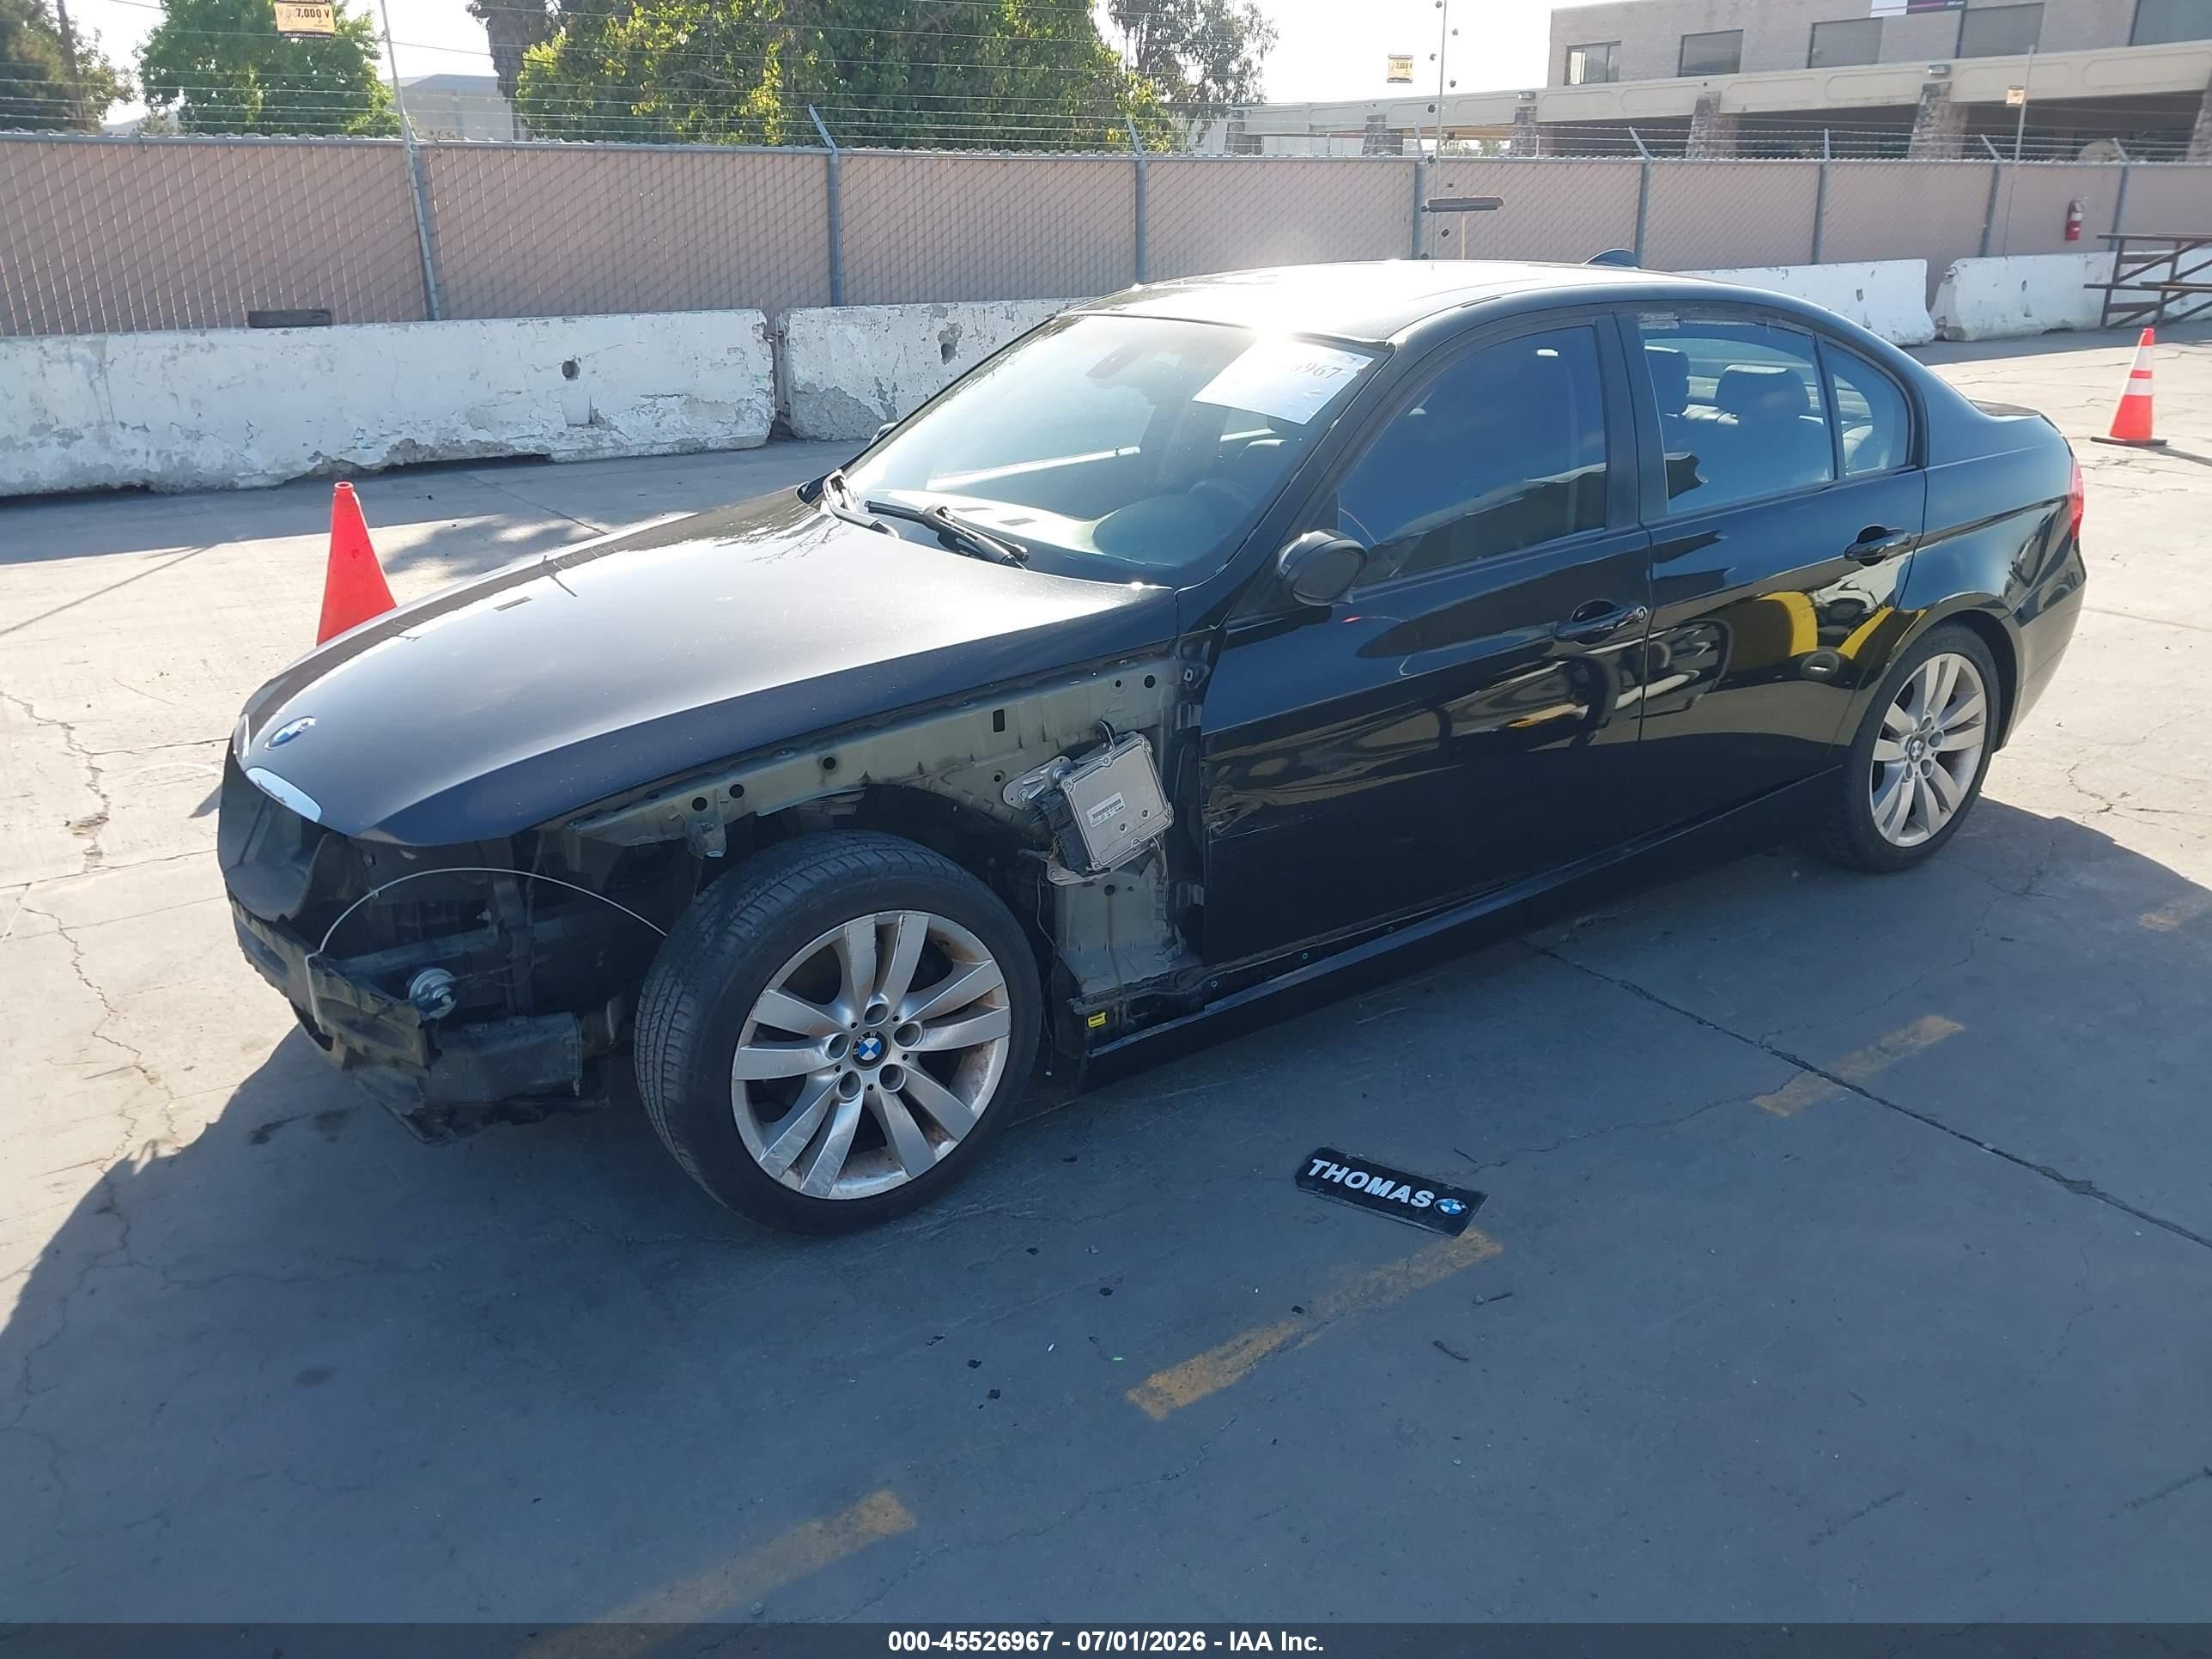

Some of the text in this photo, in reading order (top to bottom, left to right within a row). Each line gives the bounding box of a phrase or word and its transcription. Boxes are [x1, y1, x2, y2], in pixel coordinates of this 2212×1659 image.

[296, 8, 330, 18] 7,000 V
[852, 1030, 878, 1055] BMW
[1308, 1158, 1435, 1208] THOMAS
